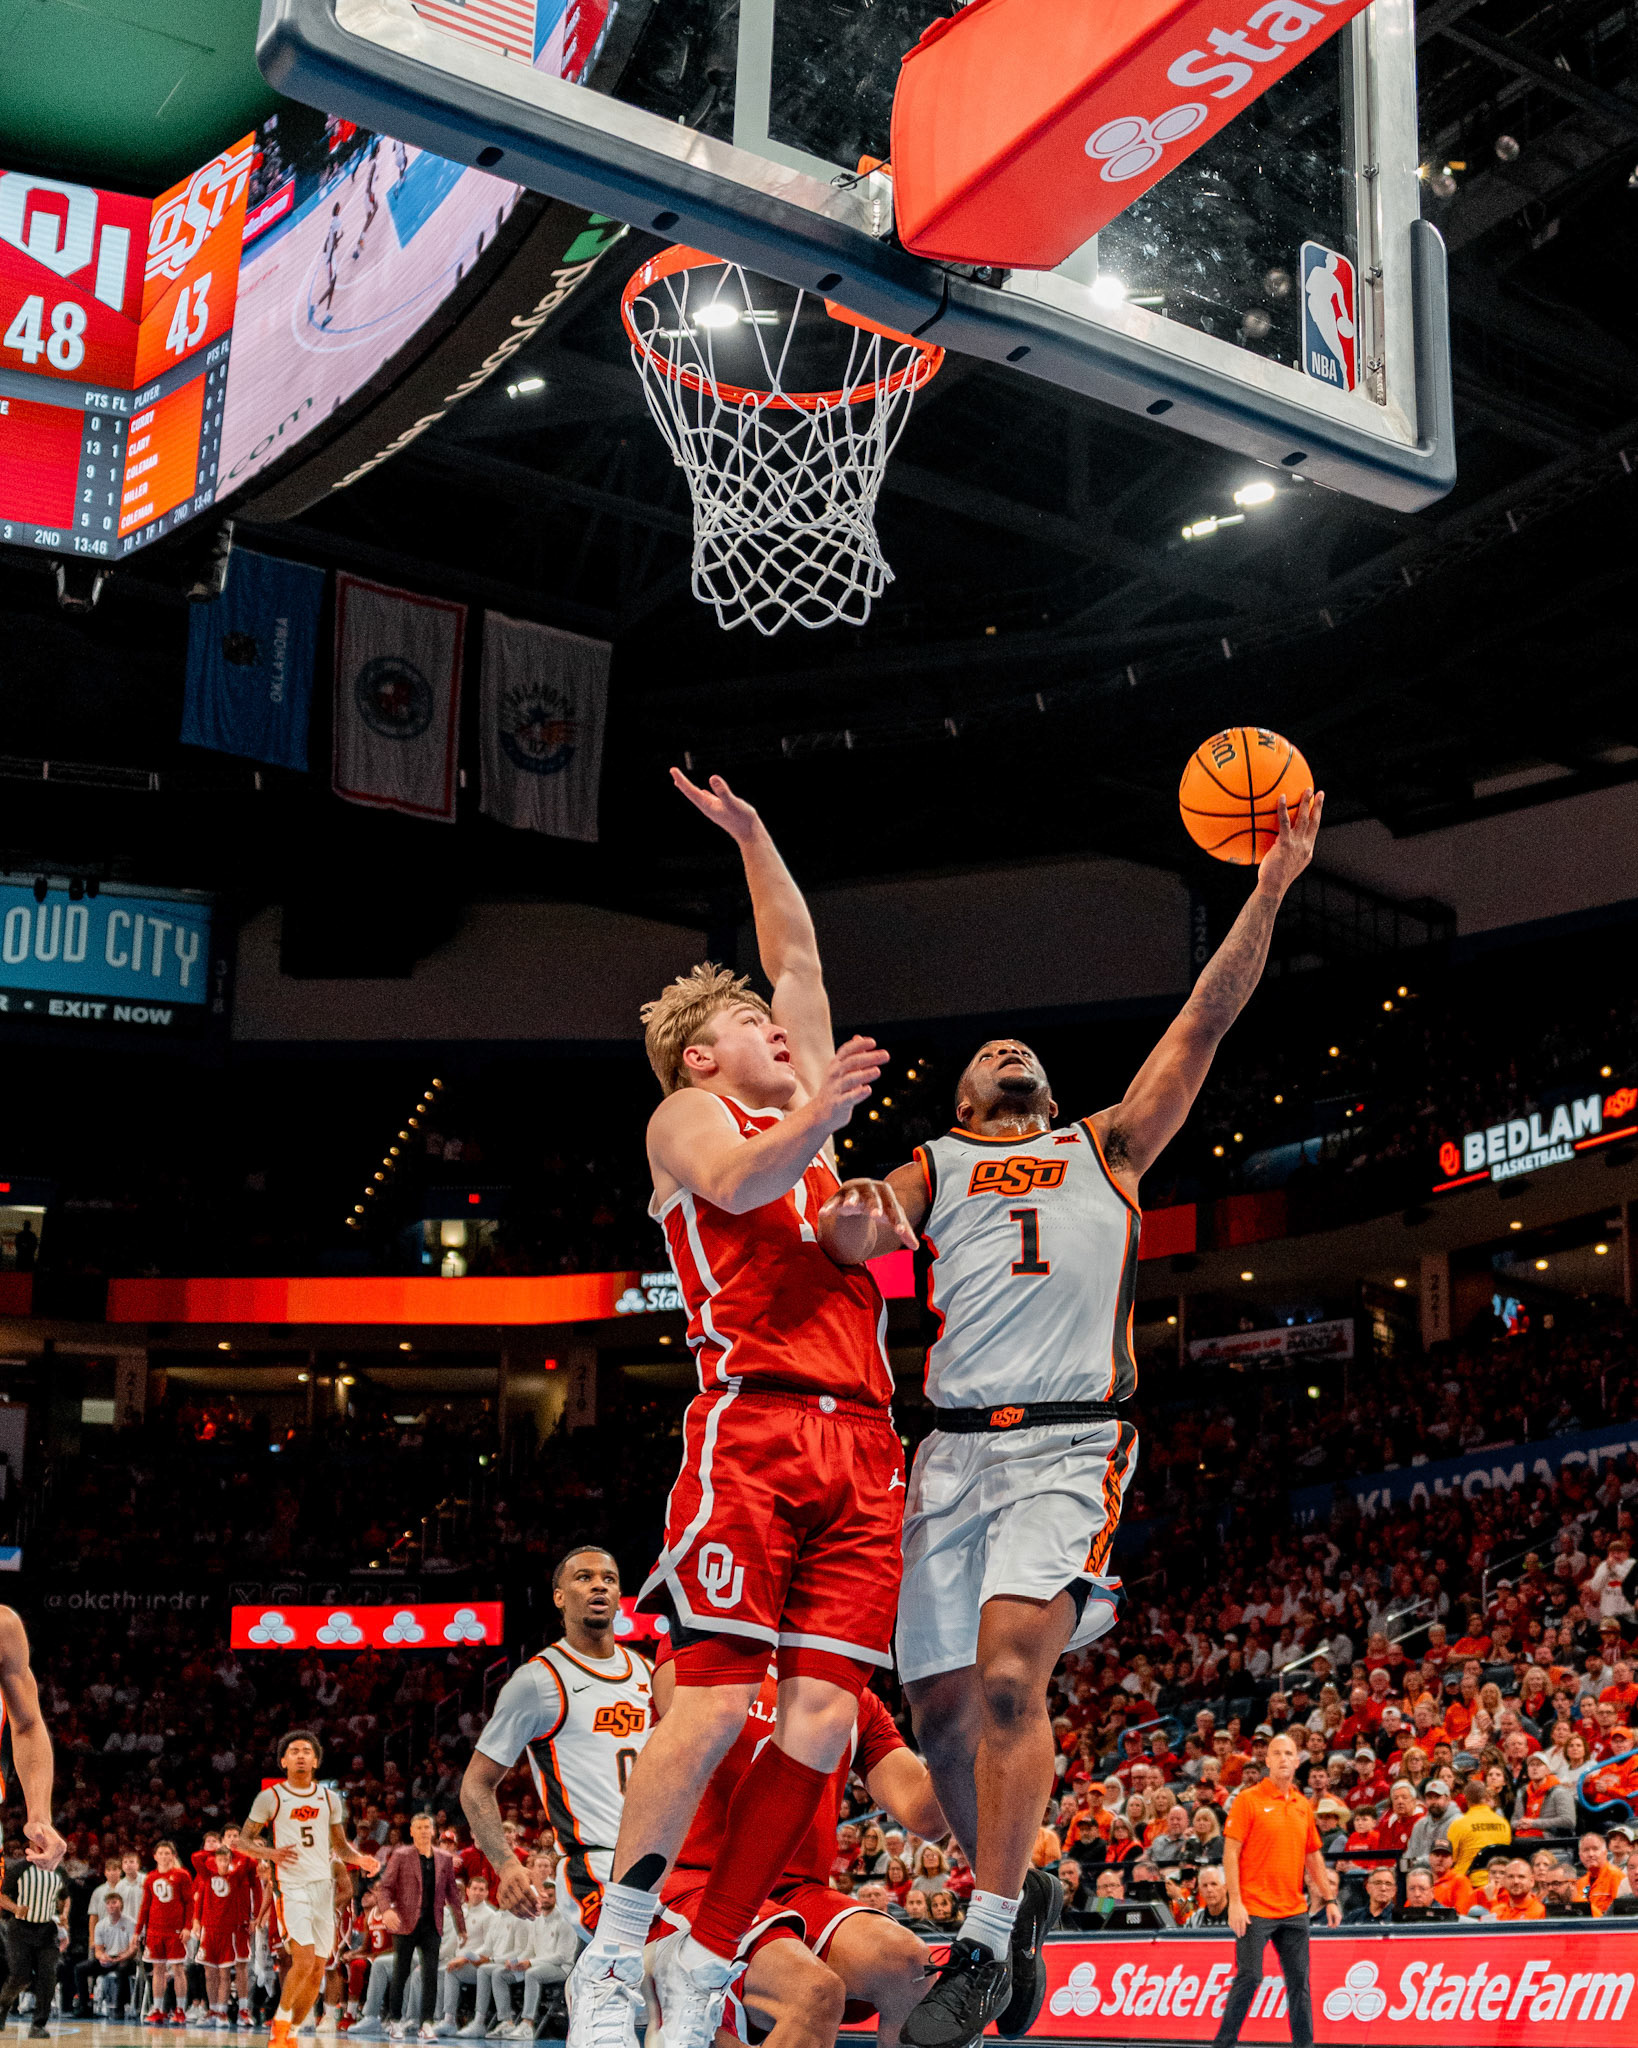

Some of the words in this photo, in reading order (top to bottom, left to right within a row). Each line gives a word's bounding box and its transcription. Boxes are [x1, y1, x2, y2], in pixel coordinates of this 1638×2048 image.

[165, 272, 212, 356] 43
[3, 295, 87, 371] 48
[206, 344, 221, 366] PTS
[221, 339, 230, 356] FL
[208, 371, 215, 386] 4
[1311, 351, 1338, 382] NBA
[85, 391, 110, 408] PTS
[112, 395, 128, 412] FL
[134, 384, 160, 410] PLAYER
[91, 416, 101, 432] 0
[114, 420, 122, 435] 1
[86, 440, 101, 456] 13
[112, 444, 119, 459] 1
[86, 465, 96, 480] 9
[109, 467, 117, 483] 1
[83, 488, 93, 503] 2
[107, 492, 115, 507] 1
[81, 512, 91, 528] 5
[102, 516, 113, 531] 0
[3, 524, 13, 540] 3
[34, 529, 61, 547] 2ND
[74, 536, 109, 556] 13:46
[105, 908, 200, 989] CITY
[48, 999, 107, 1020] EXIT
[113, 1004, 173, 1026] NOW
[1464, 1094, 1602, 1172] BEDLAM
[1491, 1142, 1576, 1182] BASKETBALL
[967, 1155, 1070, 1197] OSU
[1010, 1208, 1050, 1276] 1
[990, 1406, 1025, 1428] OSU
[697, 1542, 745, 1609] OU
[592, 1701, 646, 1738] OSU
[300, 1826, 315, 1847] 5
[1471, 1823, 1506, 1832] SECURITY
[152, 1878, 173, 1903] OU
[373, 1931, 383, 1949] 3
